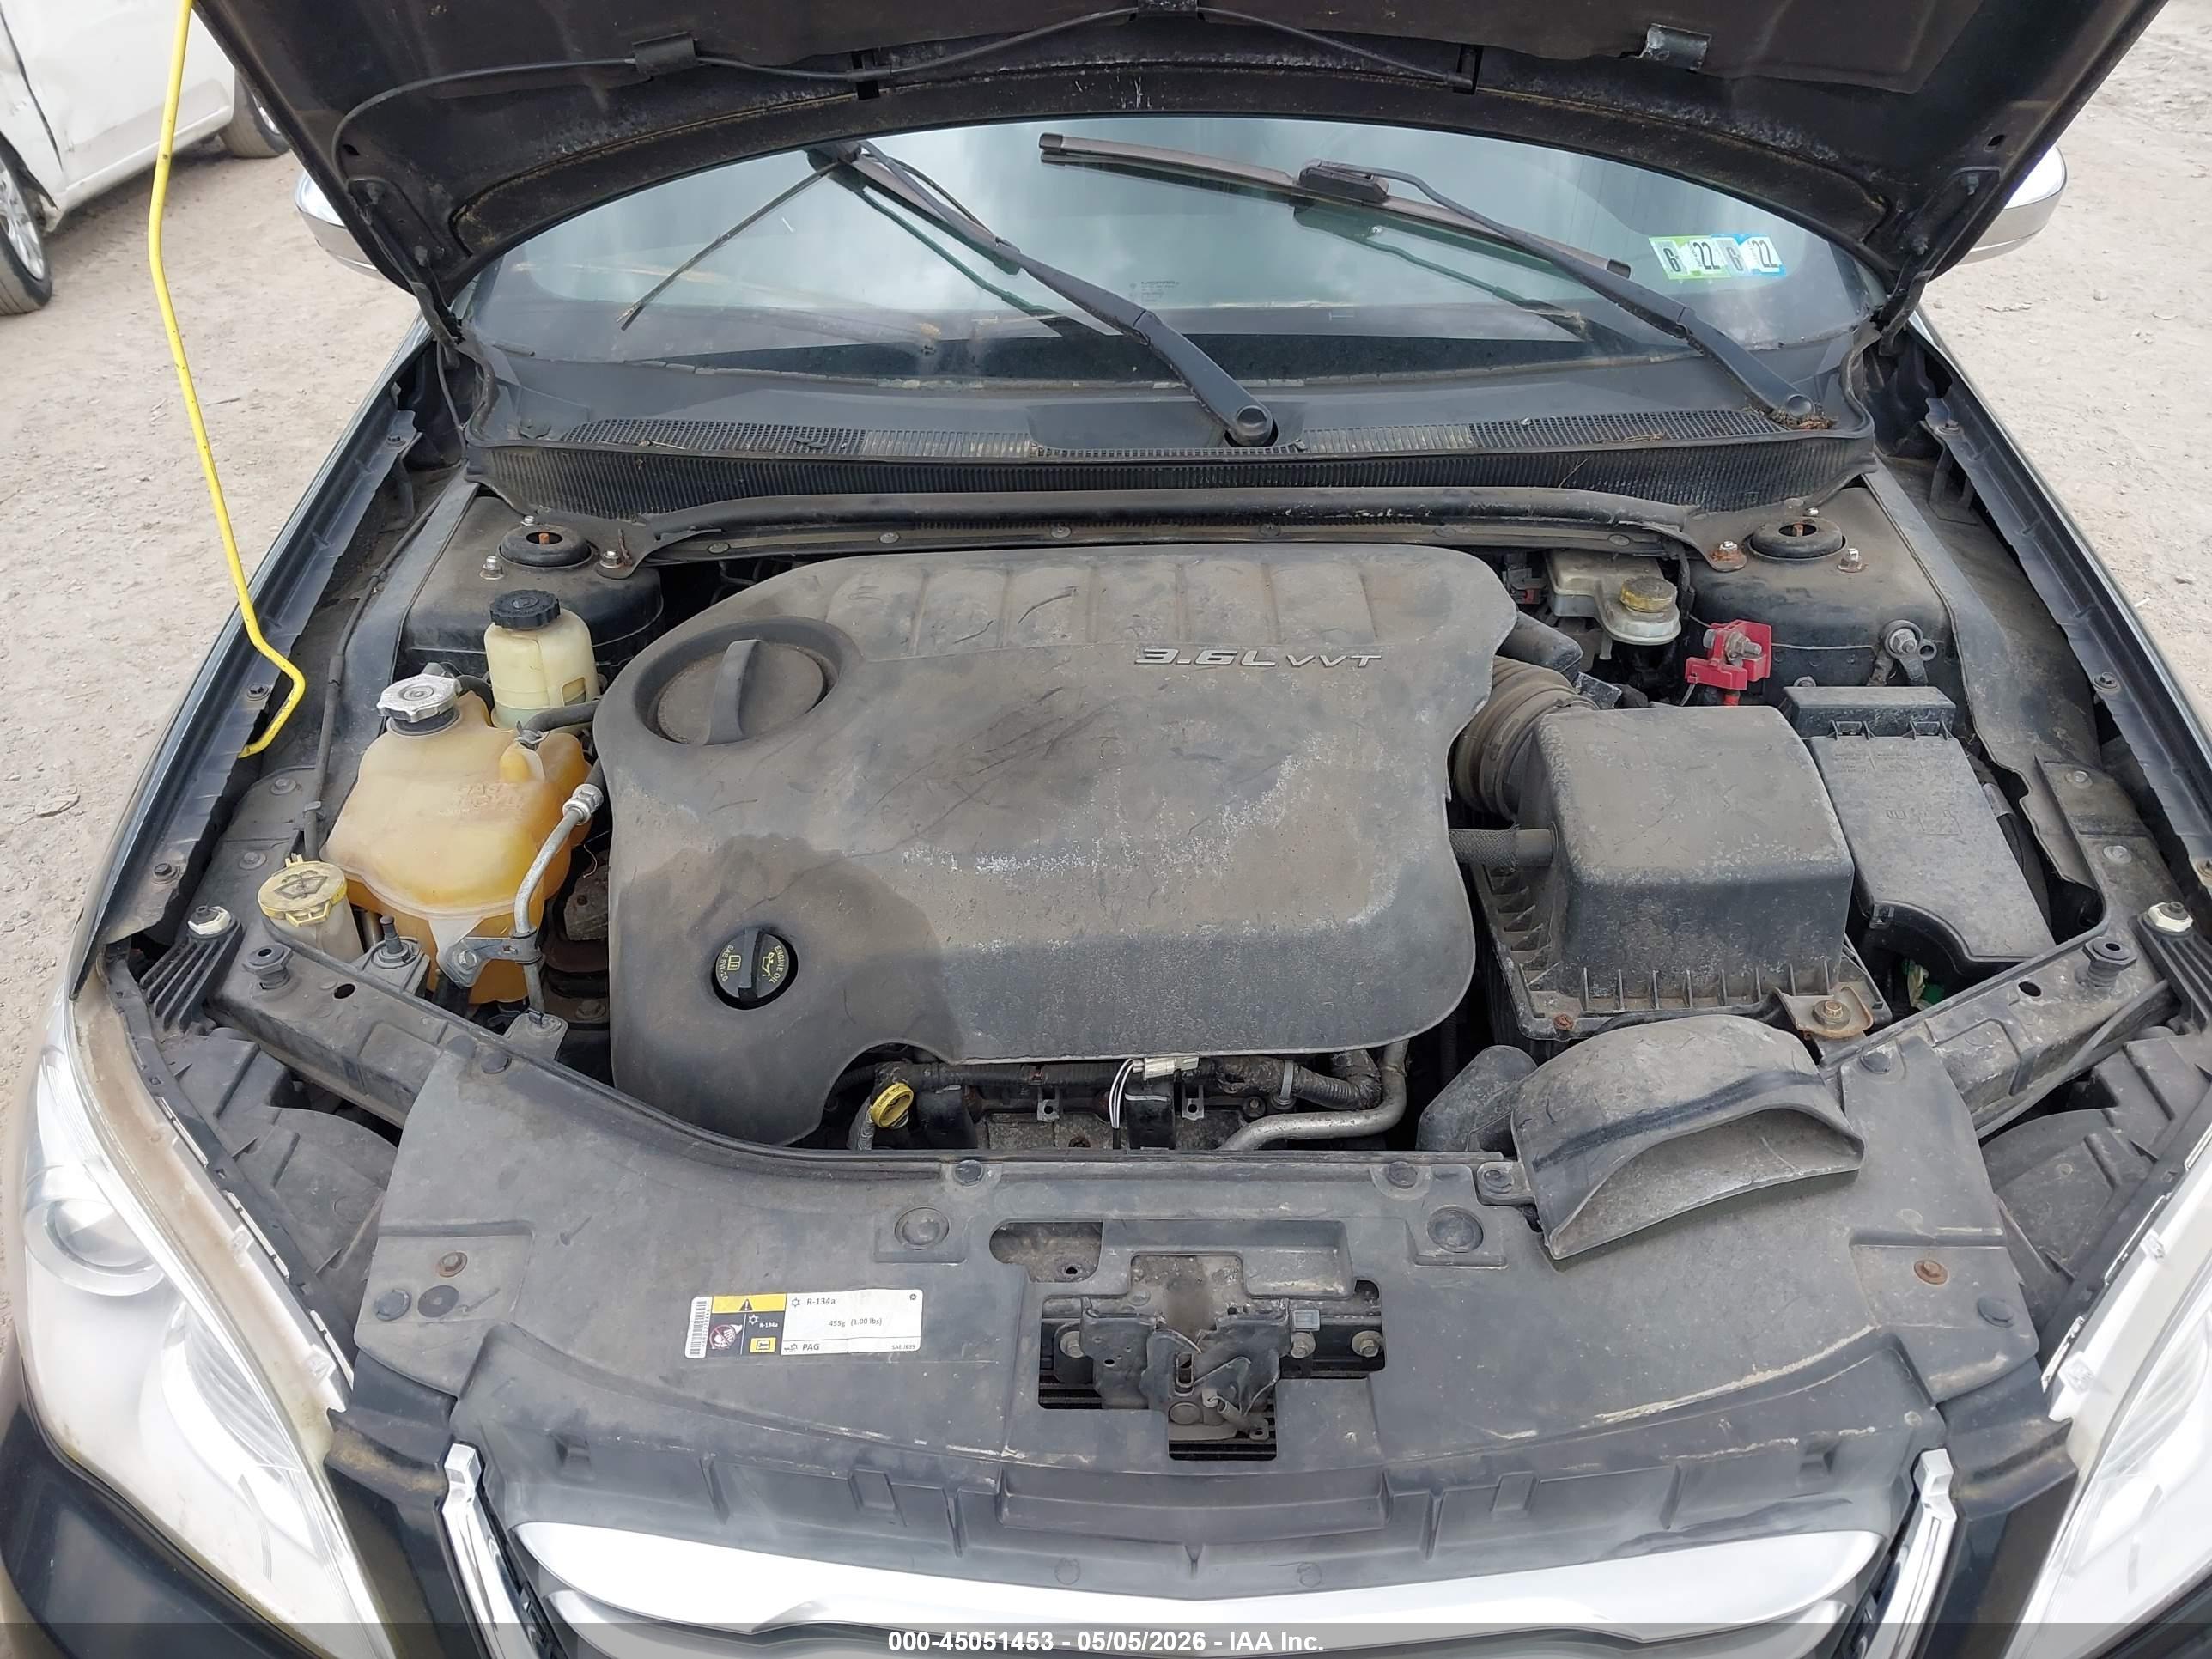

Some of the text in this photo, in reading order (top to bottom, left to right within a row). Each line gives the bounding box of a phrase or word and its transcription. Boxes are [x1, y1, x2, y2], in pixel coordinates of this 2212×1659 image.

[1663, 248, 1680, 272] 6
[1693, 242, 1720, 270] 22
[1727, 246, 1744, 271] 6
[1752, 240, 1778, 268] 22
[1135, 649, 1382, 667] 3.6L VVT
[769, 945, 785, 983] ENGINE OIL
[851, 1318, 868, 1327] (1.00
[869, 1317, 883, 1326] lbs)
[802, 1343, 820, 1352] PAG
